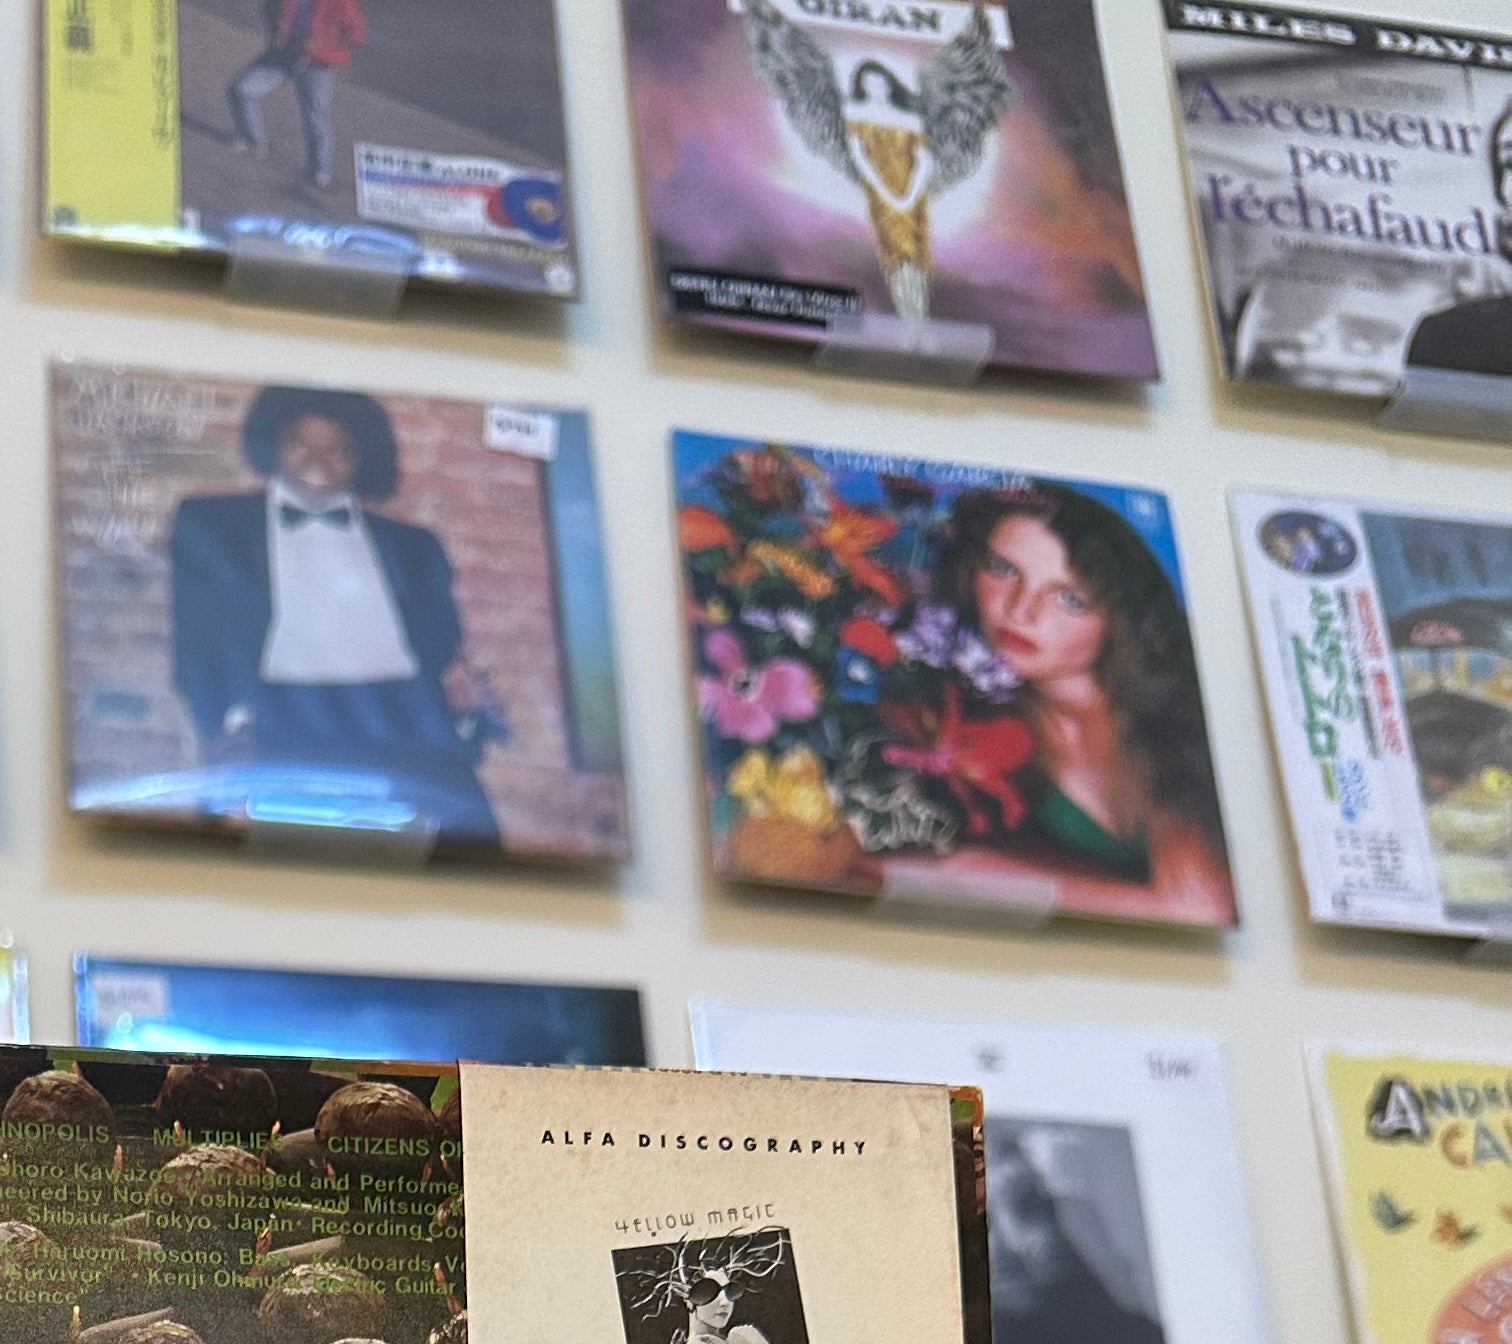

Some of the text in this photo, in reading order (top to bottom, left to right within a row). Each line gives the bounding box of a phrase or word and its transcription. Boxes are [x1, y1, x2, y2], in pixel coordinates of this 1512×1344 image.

[1181, 5, 1357, 46] MILES
[1184, 70, 1481, 156] Ascenseur
[1288, 143, 1400, 186] pour
[152, 1126, 285, 1152] MULTIPLIES
[326, 1135, 431, 1158] CITIZENS
[541, 1130, 866, 1156] ALFA DISCOGRAPHY
[73, 1162, 177, 1185] Kawazoe
[200, 1167, 302, 1192] Arranged
[311, 1173, 350, 1192] and
[77, 1182, 103, 1206] by
[112, 1184, 174, 1208] Norio
[186, 1189, 303, 1211] Yoshizawa
[311, 1195, 350, 1214] and
[363, 1196, 438, 1217] Mitsuo
[142, 1209, 218, 1234] Tokyo,
[227, 1214, 294, 1239] Japan
[310, 1216, 423, 1243] Recording
[147, 1267, 204, 1292] Kenji
[395, 1276, 457, 1297] Guitar
